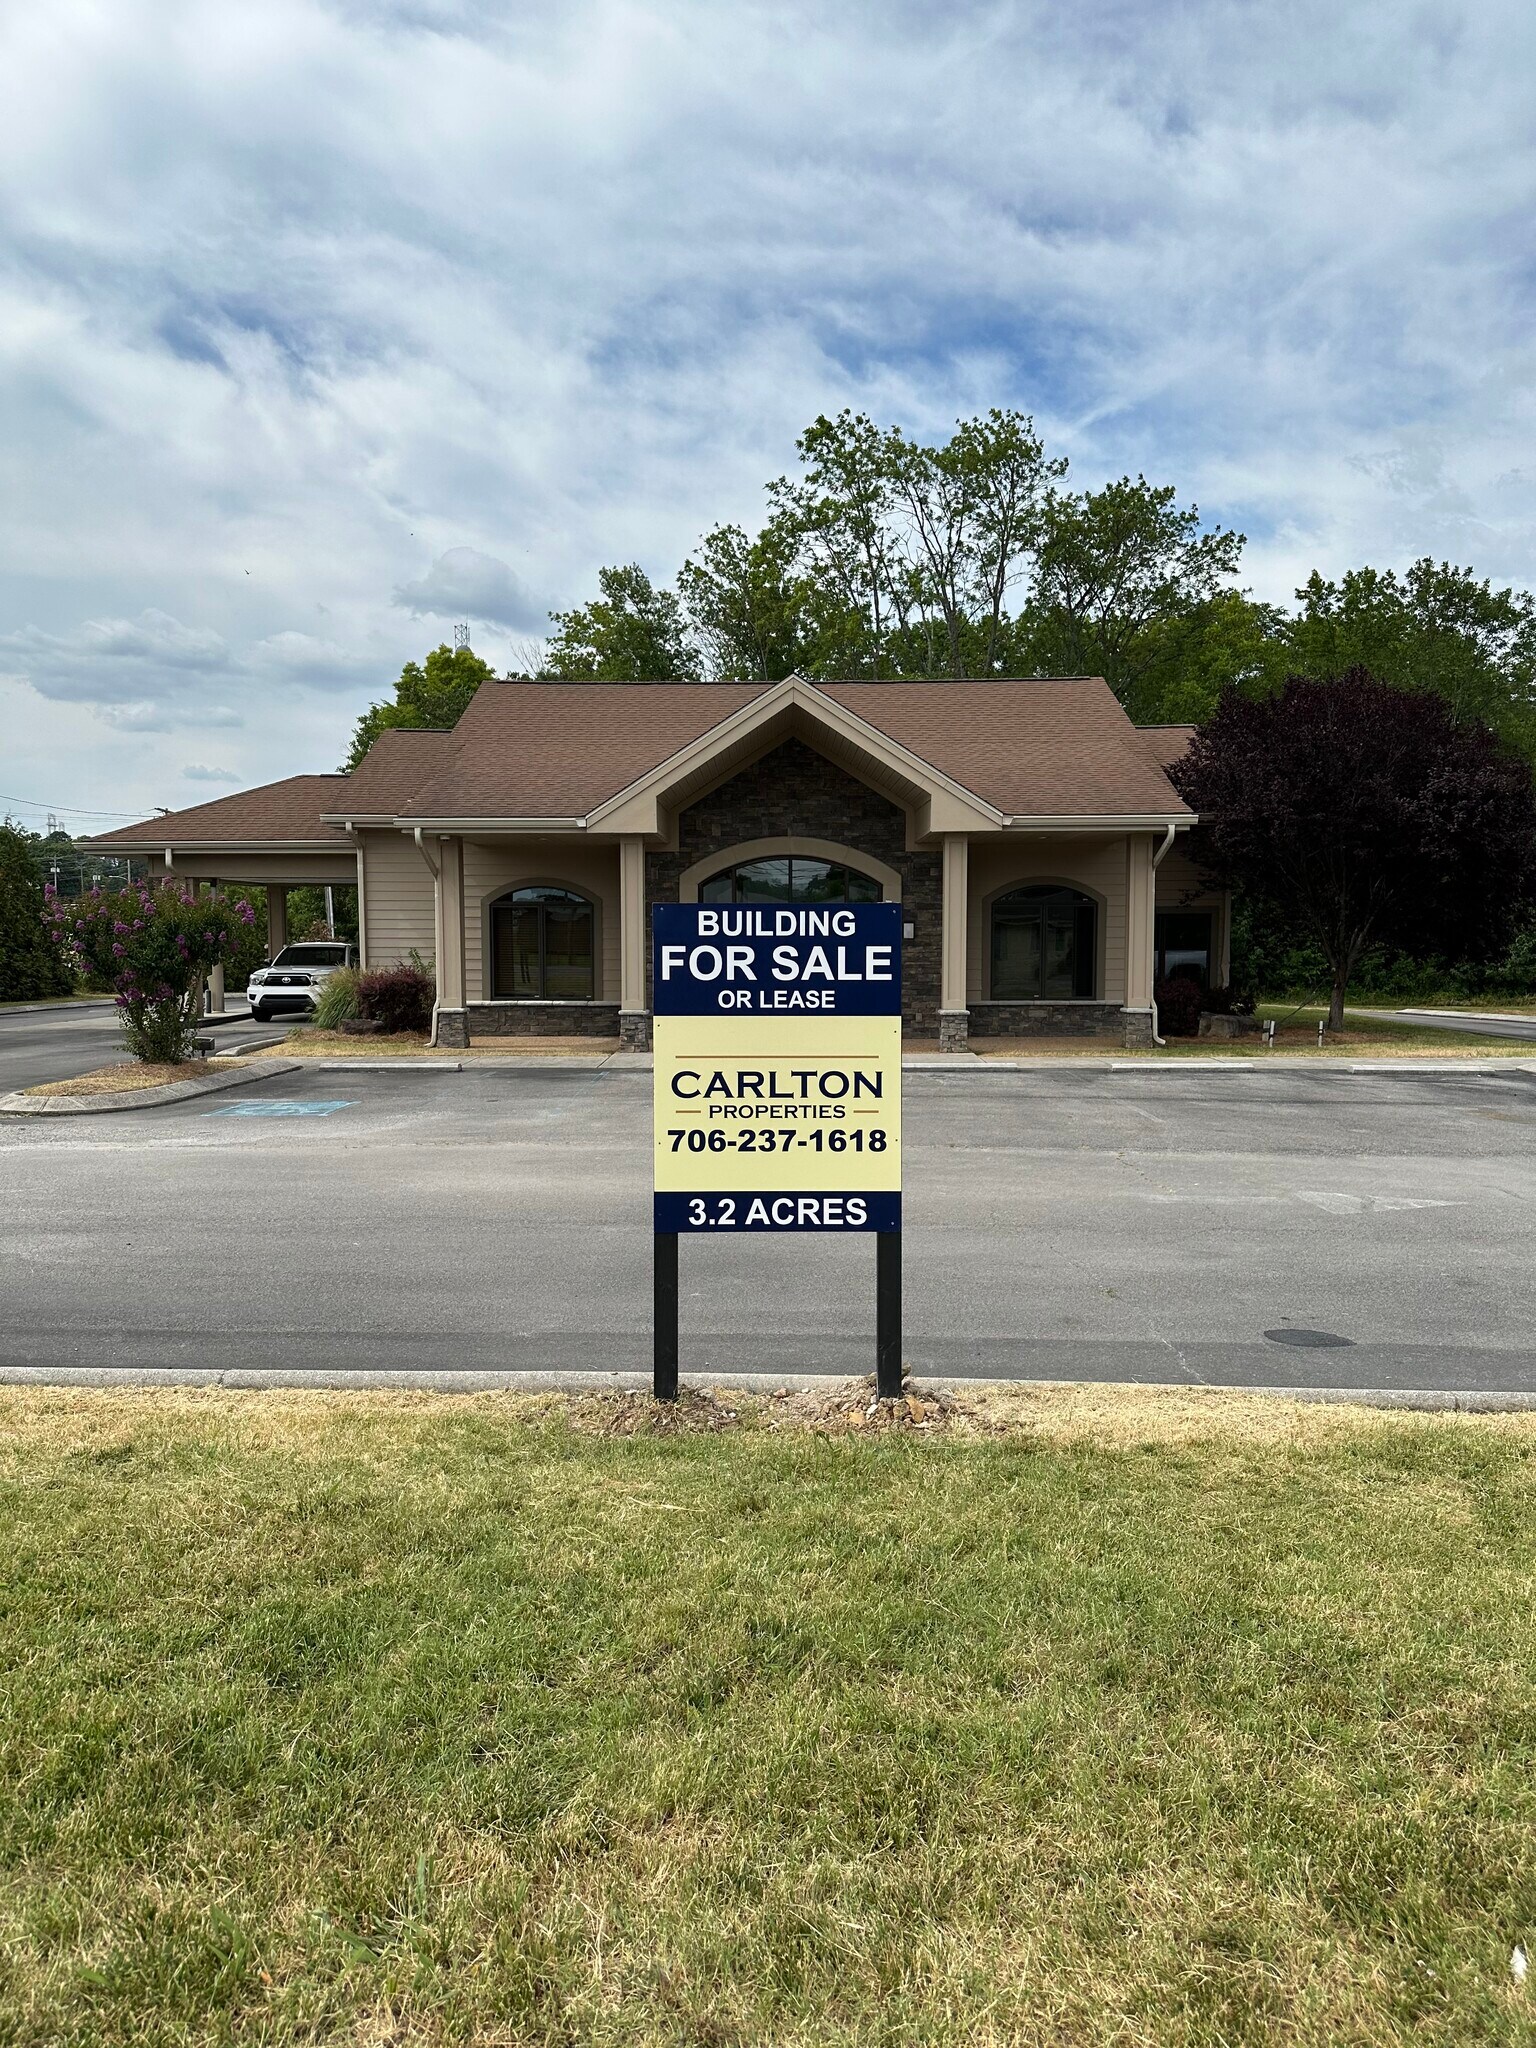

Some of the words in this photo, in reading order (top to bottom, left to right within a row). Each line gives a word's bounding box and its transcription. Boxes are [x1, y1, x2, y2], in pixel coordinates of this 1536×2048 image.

[698, 910, 856, 937] BUILDING
[661, 945, 757, 982] FOR
[771, 945, 893, 982] SALE
[717, 990, 753, 1009] OR
[759, 990, 836, 1009] LEASE
[671, 1070, 883, 1099] CARLTON
[709, 1104, 846, 1119] PROPERTIES
[667, 1129, 887, 1153] 706-237-1618
[688, 1198, 736, 1226] 3.2
[745, 1198, 868, 1226] ACRES
